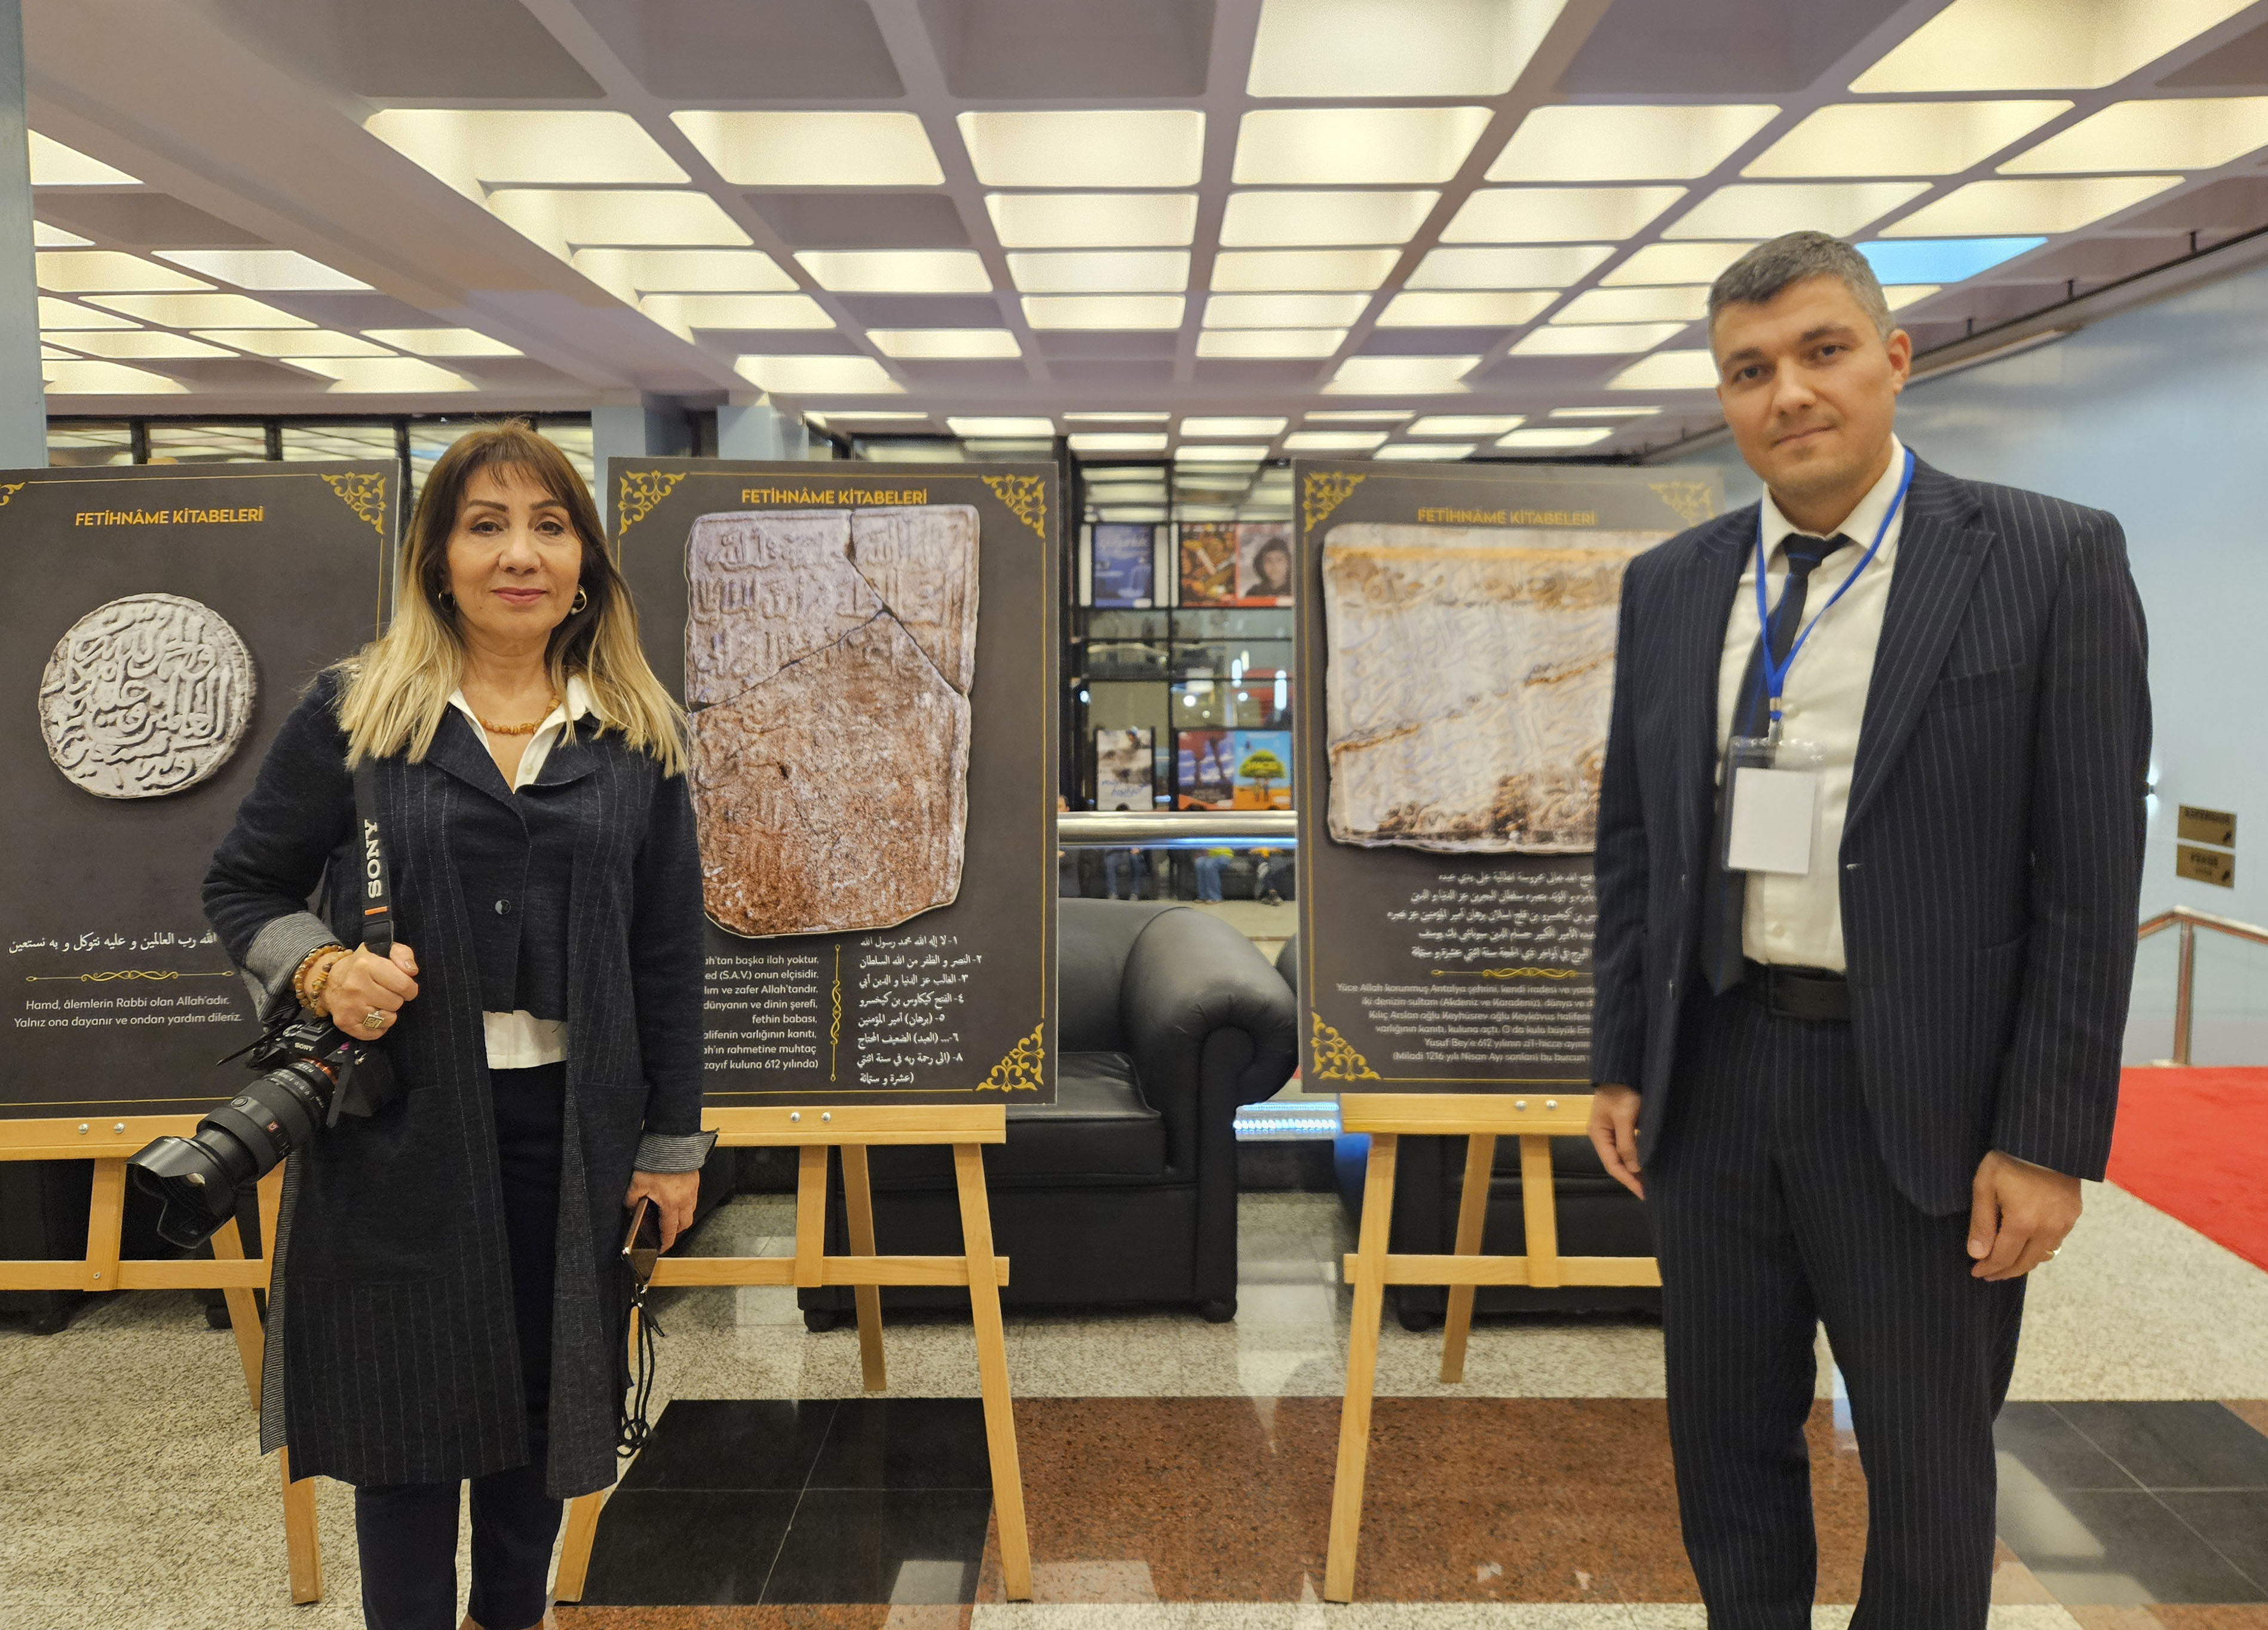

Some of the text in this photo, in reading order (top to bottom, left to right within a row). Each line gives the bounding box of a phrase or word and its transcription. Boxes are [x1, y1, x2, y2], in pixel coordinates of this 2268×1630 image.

[741, 487, 927, 505] FETİHNÂME KİTABELERİ
[75, 506, 265, 526] FETİHNÂME KİTABELERİ
[1417, 508, 1596, 525] FETİHNÂME KİTABELERİ
[364, 819, 382, 899] SONY
[9, 937, 45, 954] نستعين
[49, 939, 59, 950] به
[73, 932, 100, 951] نتوكل
[104, 933, 125, 949] عليه
[129, 939, 137, 950] و
[140, 932, 174, 950] العالمين
[178, 937, 197, 948] رب
[860, 936, 873, 946] الله
[875, 936, 896, 948] رسول
[898, 936, 912, 946] محمد
[914, 934, 927, 946] الله
[62, 942, 69, 952] و
[705, 955, 819, 967] h'tan başka ilah yoktur,
[859, 955, 890, 969] السلطان
[892, 955, 905, 964] الله
[907, 958, 918, 969] من
[920, 955, 940, 967] الظفر
[942, 958, 948, 967] و
[949, 954, 971, 967] النصر
[719, 970, 752, 981] (S.A.V.)
[781, 970, 819, 981] elçisidir.
[872, 975, 891, 988] الدين
[901, 974, 918, 986] الدنيا
[933, 973, 956, 986] الغالب
[893, 978, 899, 987] و
[920, 978, 930, 986] عز
[735, 985, 759, 994] zafer
[761, 985, 818, 994] Allah'tandır.
[1336, 983, 1358, 992] Yüce
[1360, 983, 1383, 992] Allah
[1430, 984, 1466, 994] Antalya
[26, 1000, 61, 1010] Hamd,
[63, 998, 113, 1009] âlemlerin
[116, 997, 148, 1007] Rabbi
[150, 997, 174, 1007] olan
[859, 991, 892, 1007] كيخسرو
[891, 997, 900, 1007] بن
[903, 991, 935, 1007] كيكاوس
[934, 993, 952, 1009] الفتح
[703, 1000, 747, 1012] dünyanın
[764, 1000, 787, 1009] dinin
[790, 999, 818, 1010] şerefi,
[14, 1018, 46, 1028] Yalnız
[71, 1016, 112, 1028] dayanır
[130, 1015, 165, 1025] ondan
[168, 1013, 206, 1026] yardım
[752, 1014, 817, 1024] fethin babası,
[858, 1013, 885, 1028] المؤمنين
[888, 1012, 903, 1026] أمير
[704, 1029, 817, 1040] alifenin varlığının kanıtı,
[1502, 1025, 1512, 1034] O
[857, 1032, 879, 1050] المحتاج
[882, 1032, 911, 1044] الضعيف
[1424, 1038, 1450, 1047] Yusuf
[1478, 1038, 1492, 1047] 612
[295, 1042, 315, 1052] SONY
[727, 1044, 777, 1054] rahmetine
[779, 1044, 817, 1055] muhtaç
[876, 1053, 891, 1063] سنة
[893, 1053, 902, 1066] في
[904, 1055, 915, 1065] ربه
[917, 1052, 933, 1065] رحمة
[704, 1059, 819, 1071] zayıf kuluna 612 yılında)
[882, 1076, 888, 1085] و
